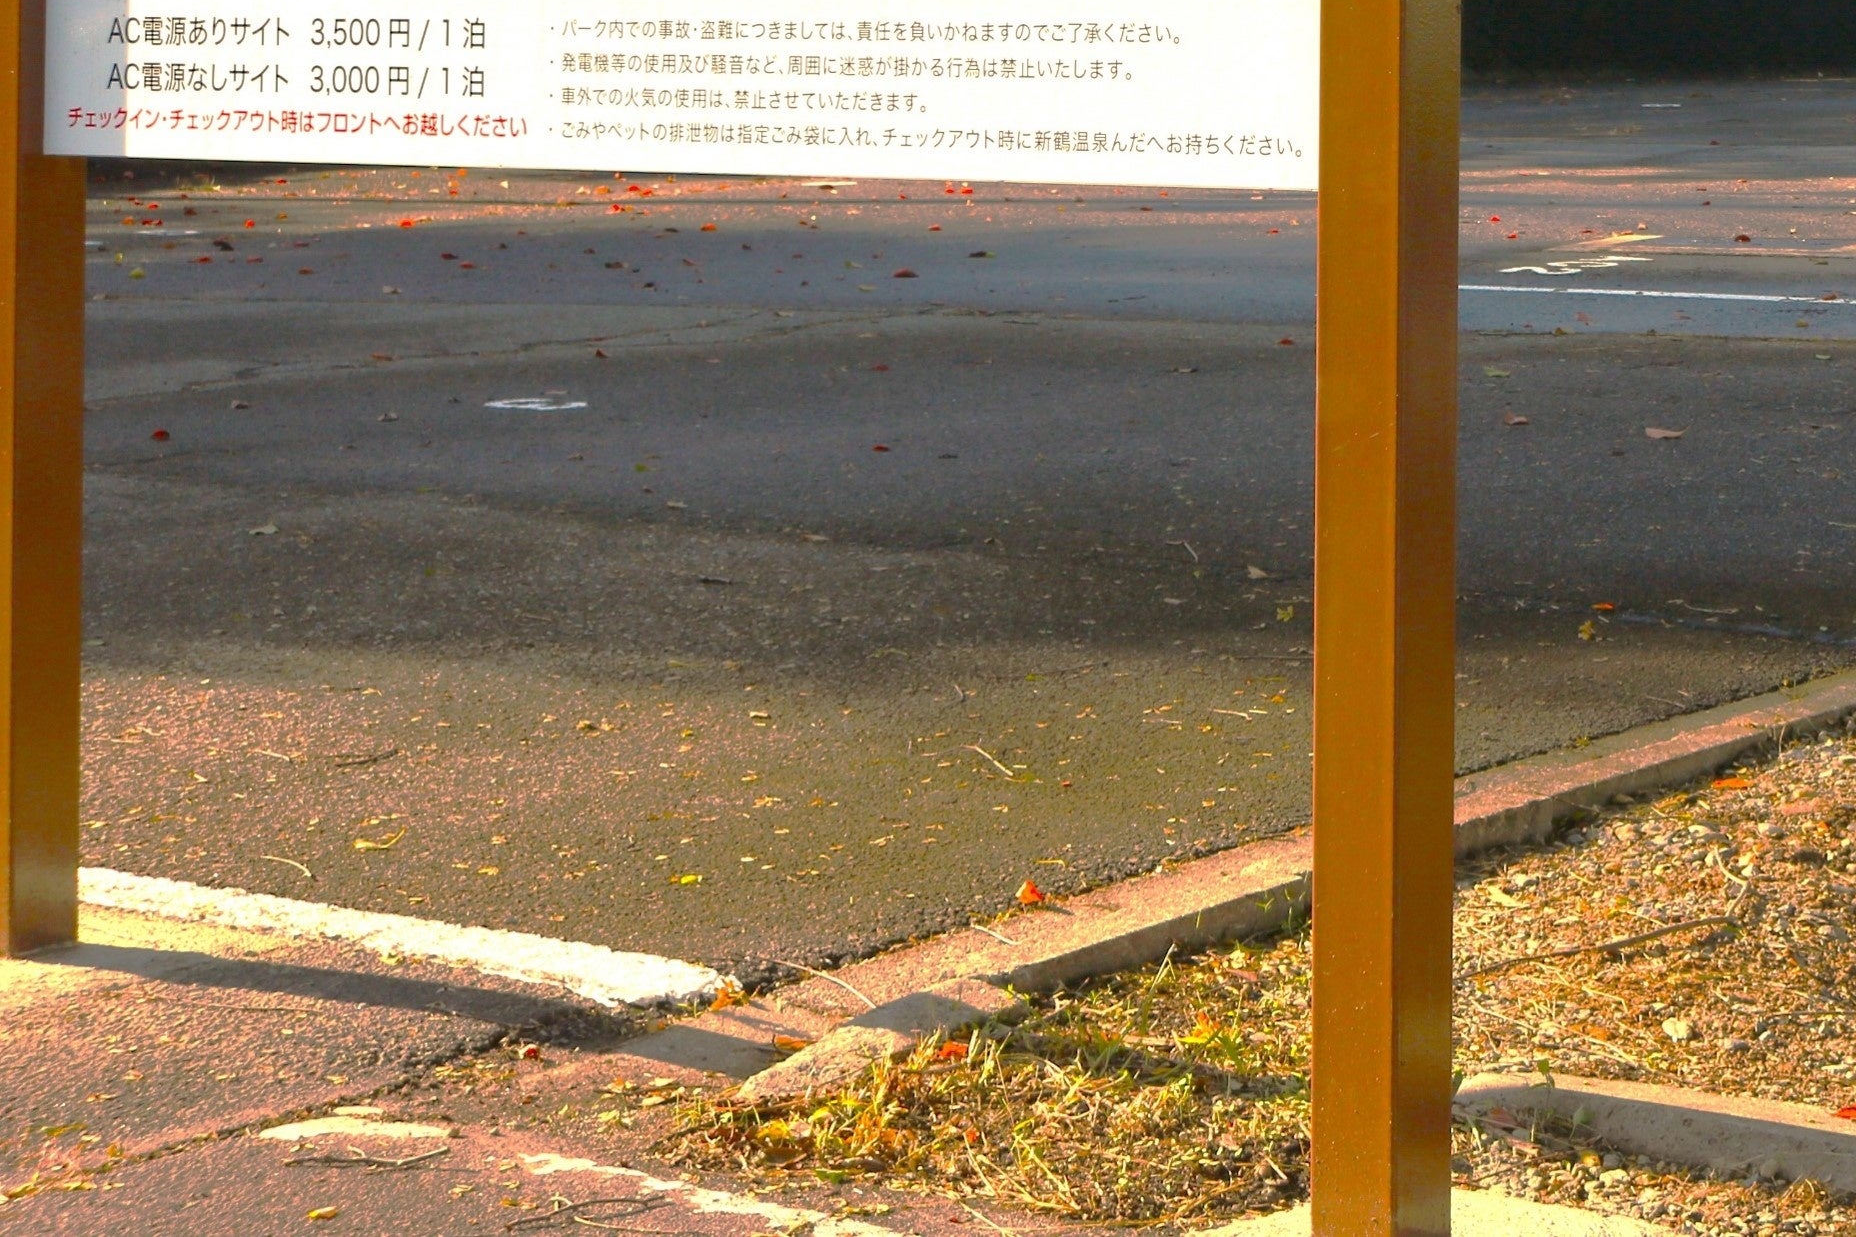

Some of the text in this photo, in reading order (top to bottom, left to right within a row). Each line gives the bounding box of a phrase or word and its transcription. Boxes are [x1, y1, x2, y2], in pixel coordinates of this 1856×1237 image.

[107, 16, 290, 48] AC電源ありサイト
[106, 62, 290, 94] AC電源なしサイト
[67, 107, 528, 138] チェックイン・チェックアウト時はフロントへお越しください
